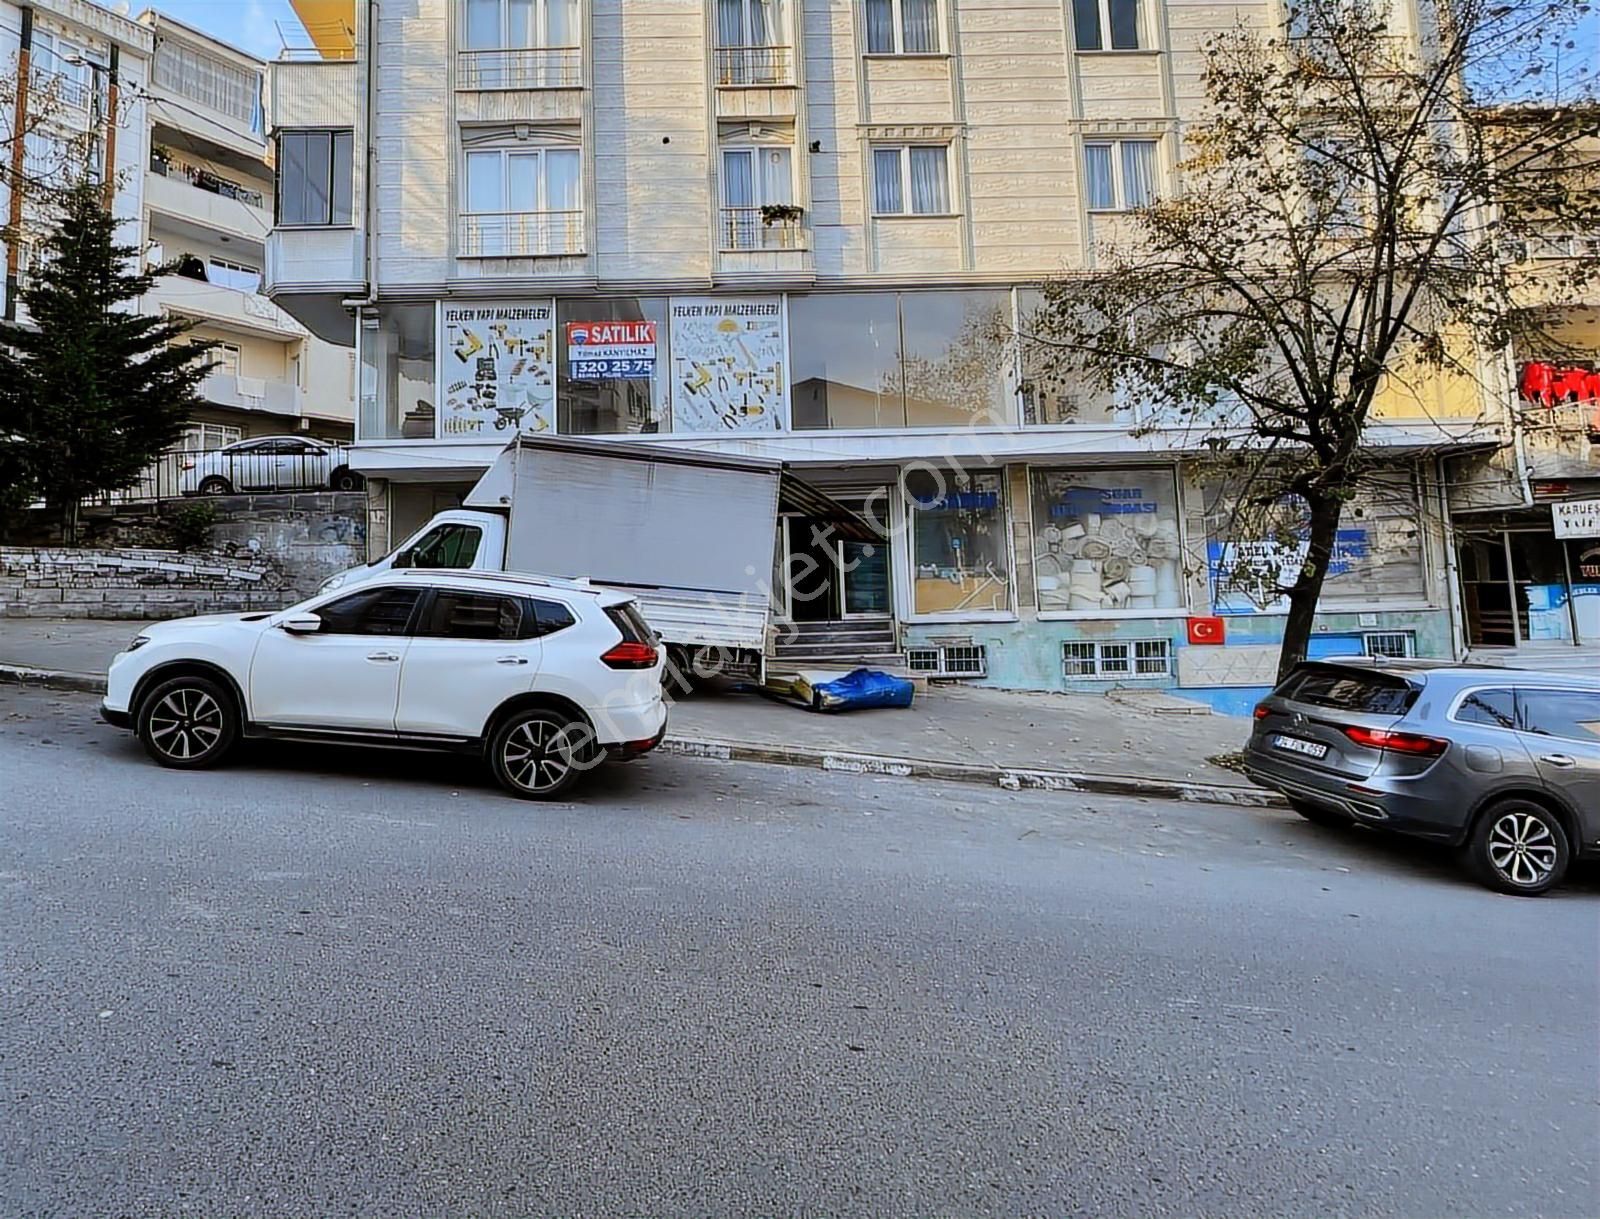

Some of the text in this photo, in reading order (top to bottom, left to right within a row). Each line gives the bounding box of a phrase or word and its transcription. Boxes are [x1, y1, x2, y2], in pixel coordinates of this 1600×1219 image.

[446, 310, 476, 323] YELKEN
[673, 305, 702, 317] YELKEN
[592, 325, 651, 343] SATILIK
[578, 360, 653, 373] 320 25 75
